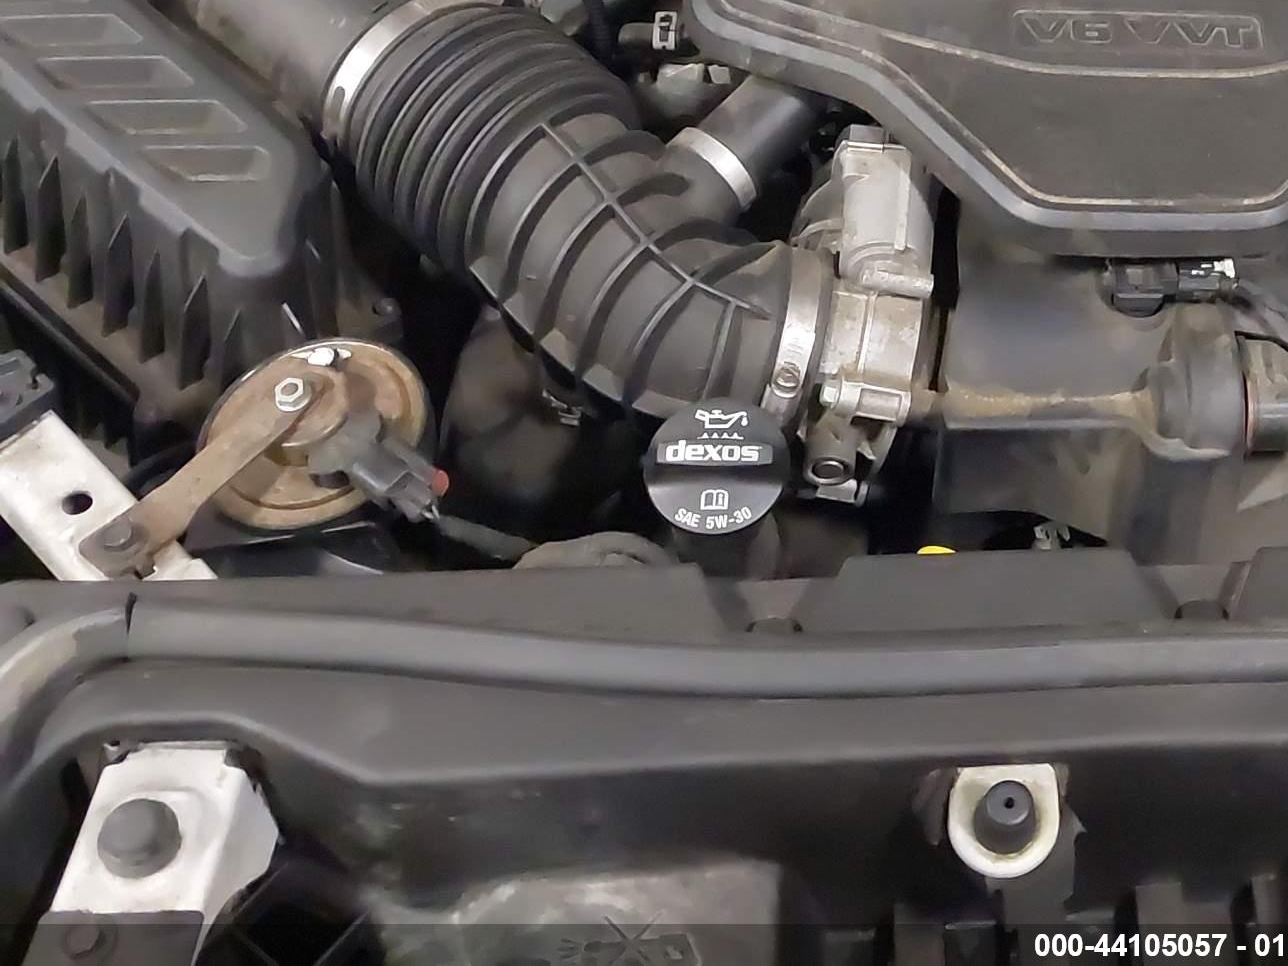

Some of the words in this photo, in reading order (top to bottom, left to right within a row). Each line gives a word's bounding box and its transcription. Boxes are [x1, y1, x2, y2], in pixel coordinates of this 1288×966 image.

[1022, 18, 1112, 44] V6
[1123, 19, 1253, 47] VVT
[666, 439, 760, 462] dexos
[674, 507, 701, 528] SAE
[705, 506, 752, 530] 5W-30
